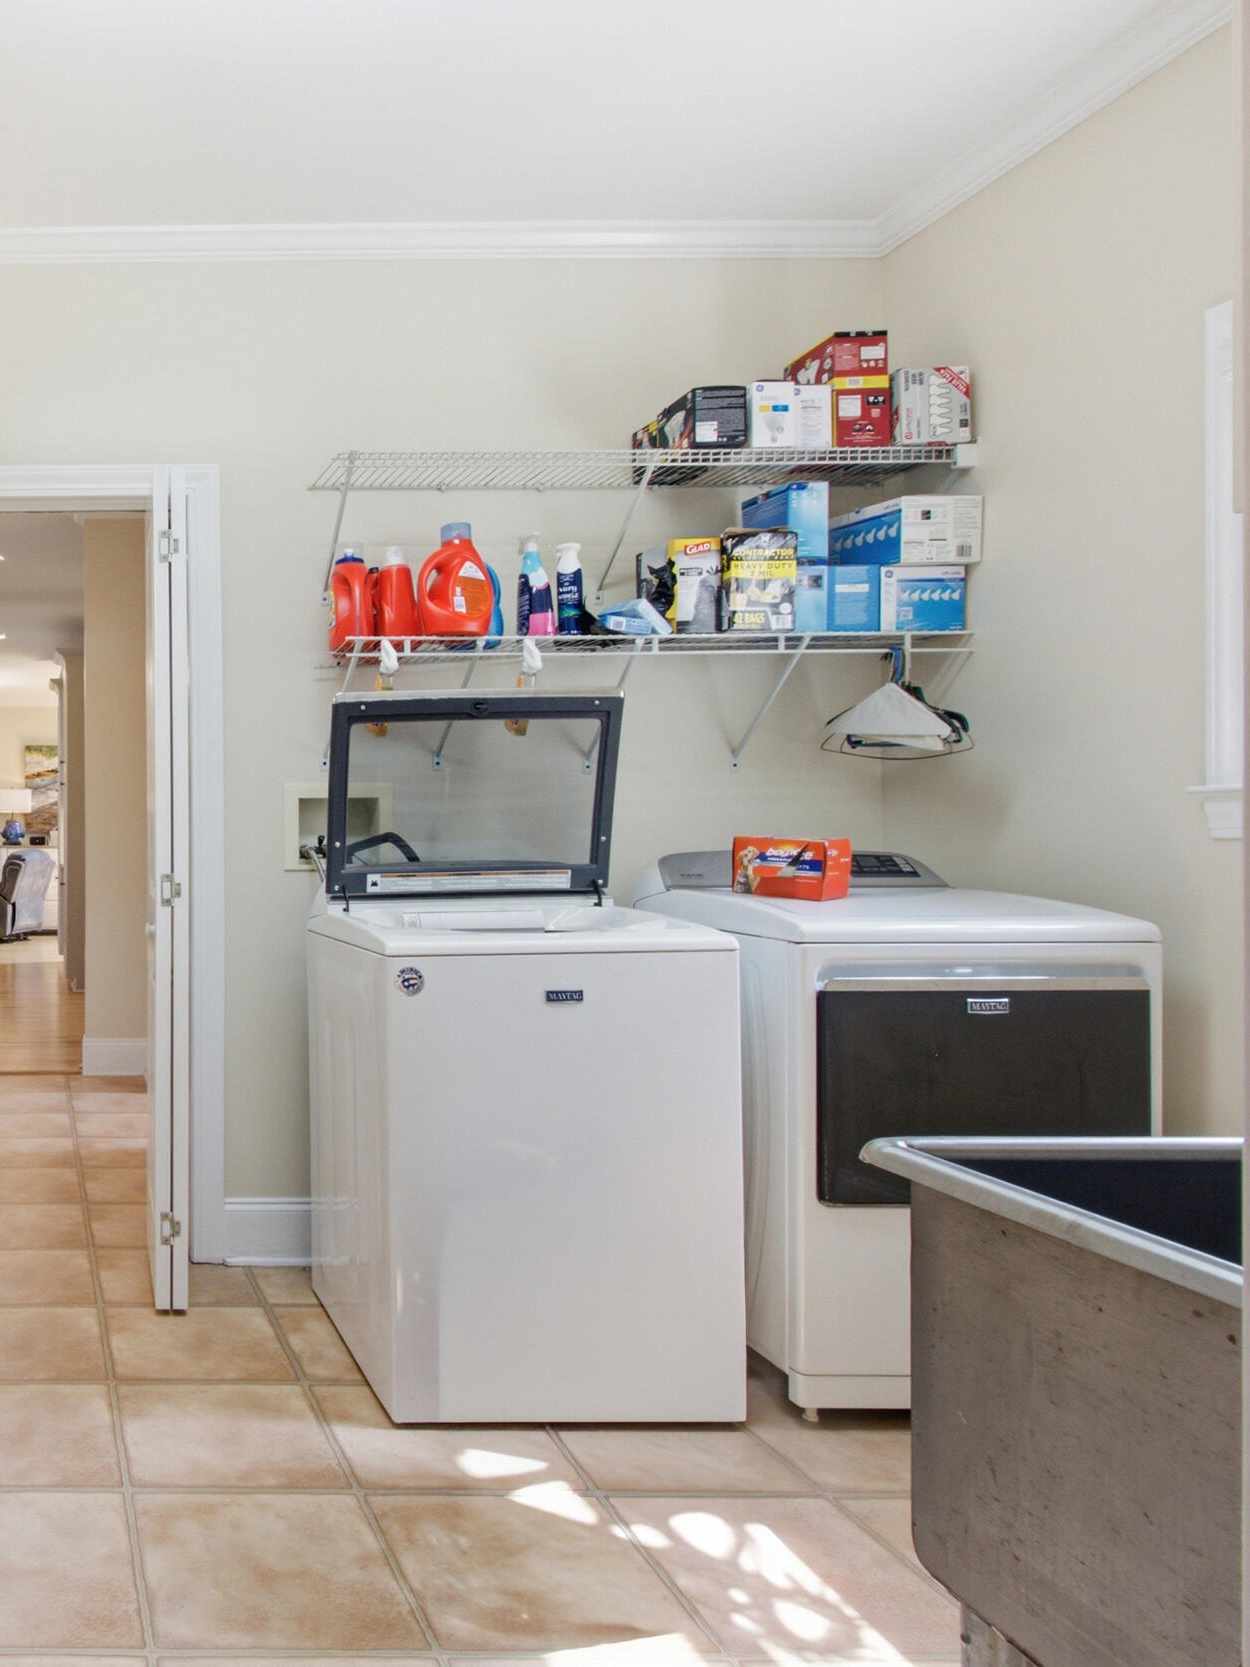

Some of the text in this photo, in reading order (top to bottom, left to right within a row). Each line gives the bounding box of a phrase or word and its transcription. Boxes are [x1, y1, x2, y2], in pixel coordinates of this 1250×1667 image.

[686, 543, 711, 553] GLAD
[732, 548, 794, 556] CONTRACTOR
[744, 613, 766, 624] BAGS
[548, 992, 582, 1000] MAYTAG
[972, 1002, 1007, 1010] MAYTAG
